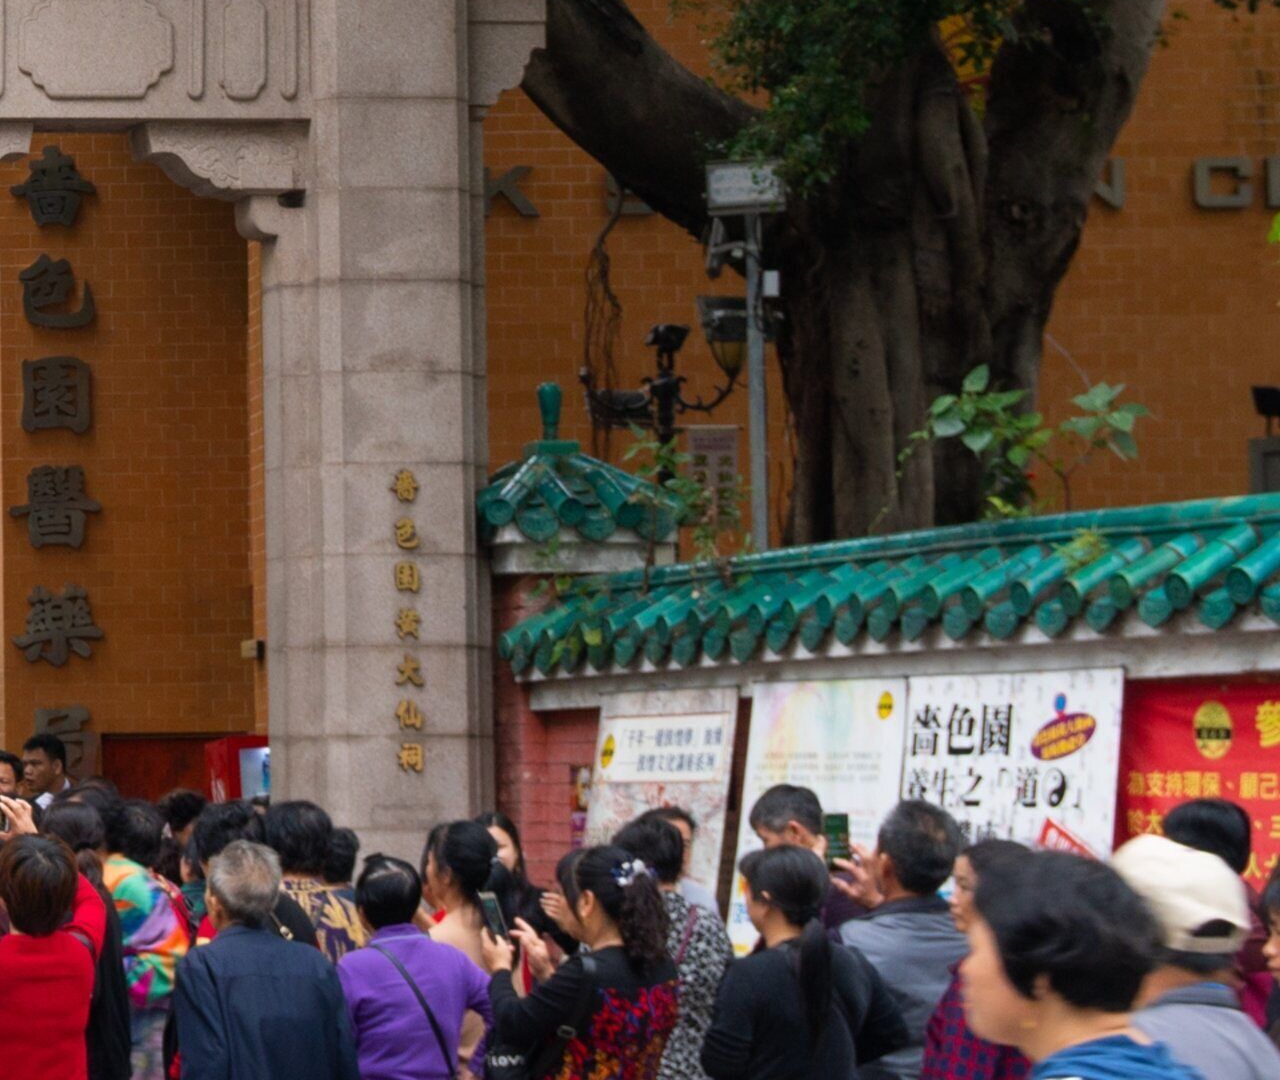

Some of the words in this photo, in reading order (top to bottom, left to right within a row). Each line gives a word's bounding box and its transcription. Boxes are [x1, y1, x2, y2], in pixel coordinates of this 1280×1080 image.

[389, 470, 424, 772] 嗇色園黃大仙祠
[911, 703, 1014, 757] 嗇色園
